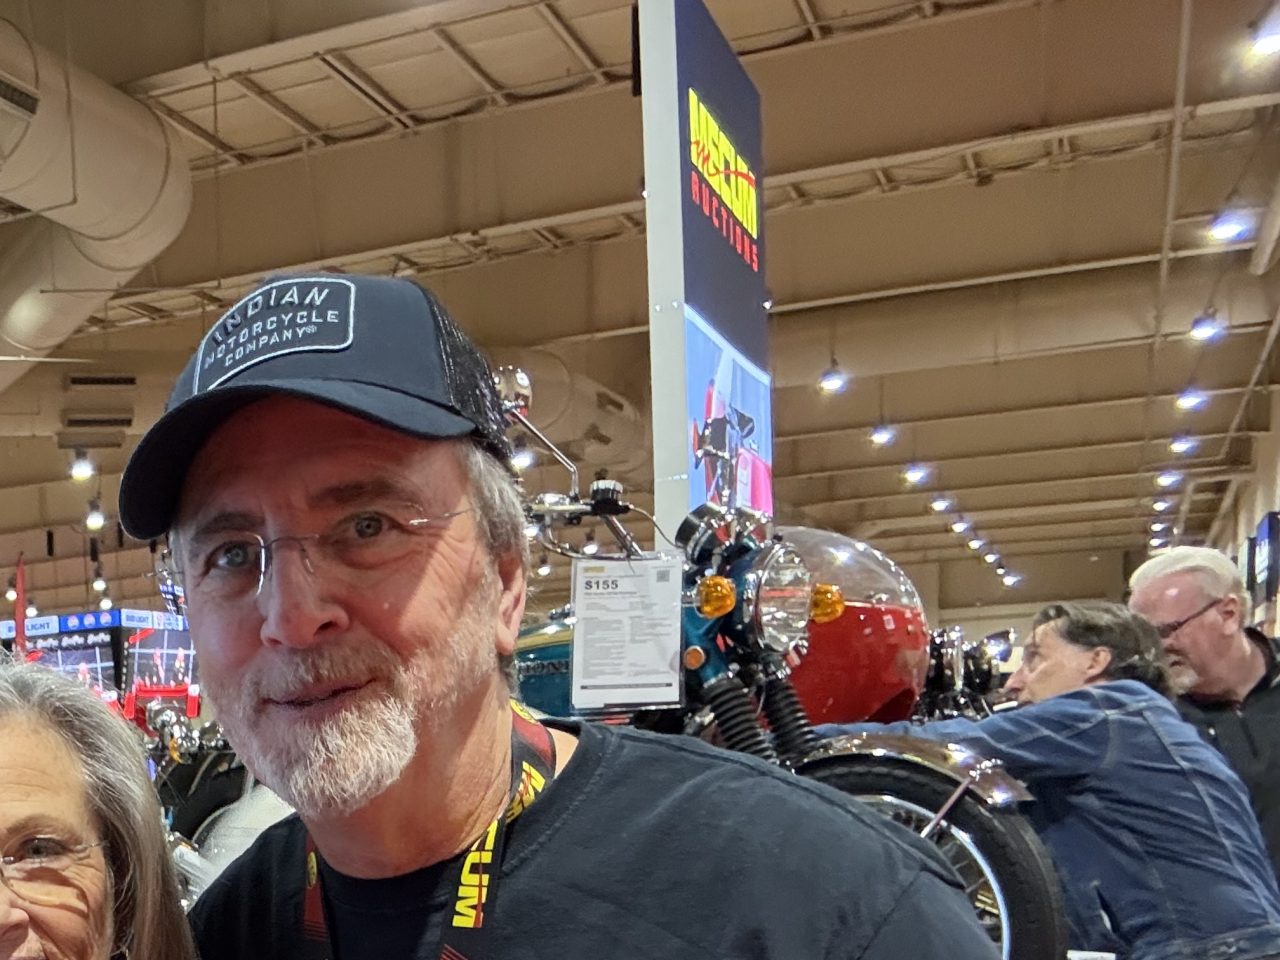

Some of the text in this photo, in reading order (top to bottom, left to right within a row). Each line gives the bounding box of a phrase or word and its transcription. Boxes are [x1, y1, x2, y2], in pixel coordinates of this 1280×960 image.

[689, 87, 759, 240] MECUM
[690, 170, 759, 272] AUCTIONS
[204, 310, 340, 370] MOTORCYCLE
[213, 286, 329, 346] INDIAN
[225, 327, 307, 368] COMPANY
[584, 580, 619, 590] S155
